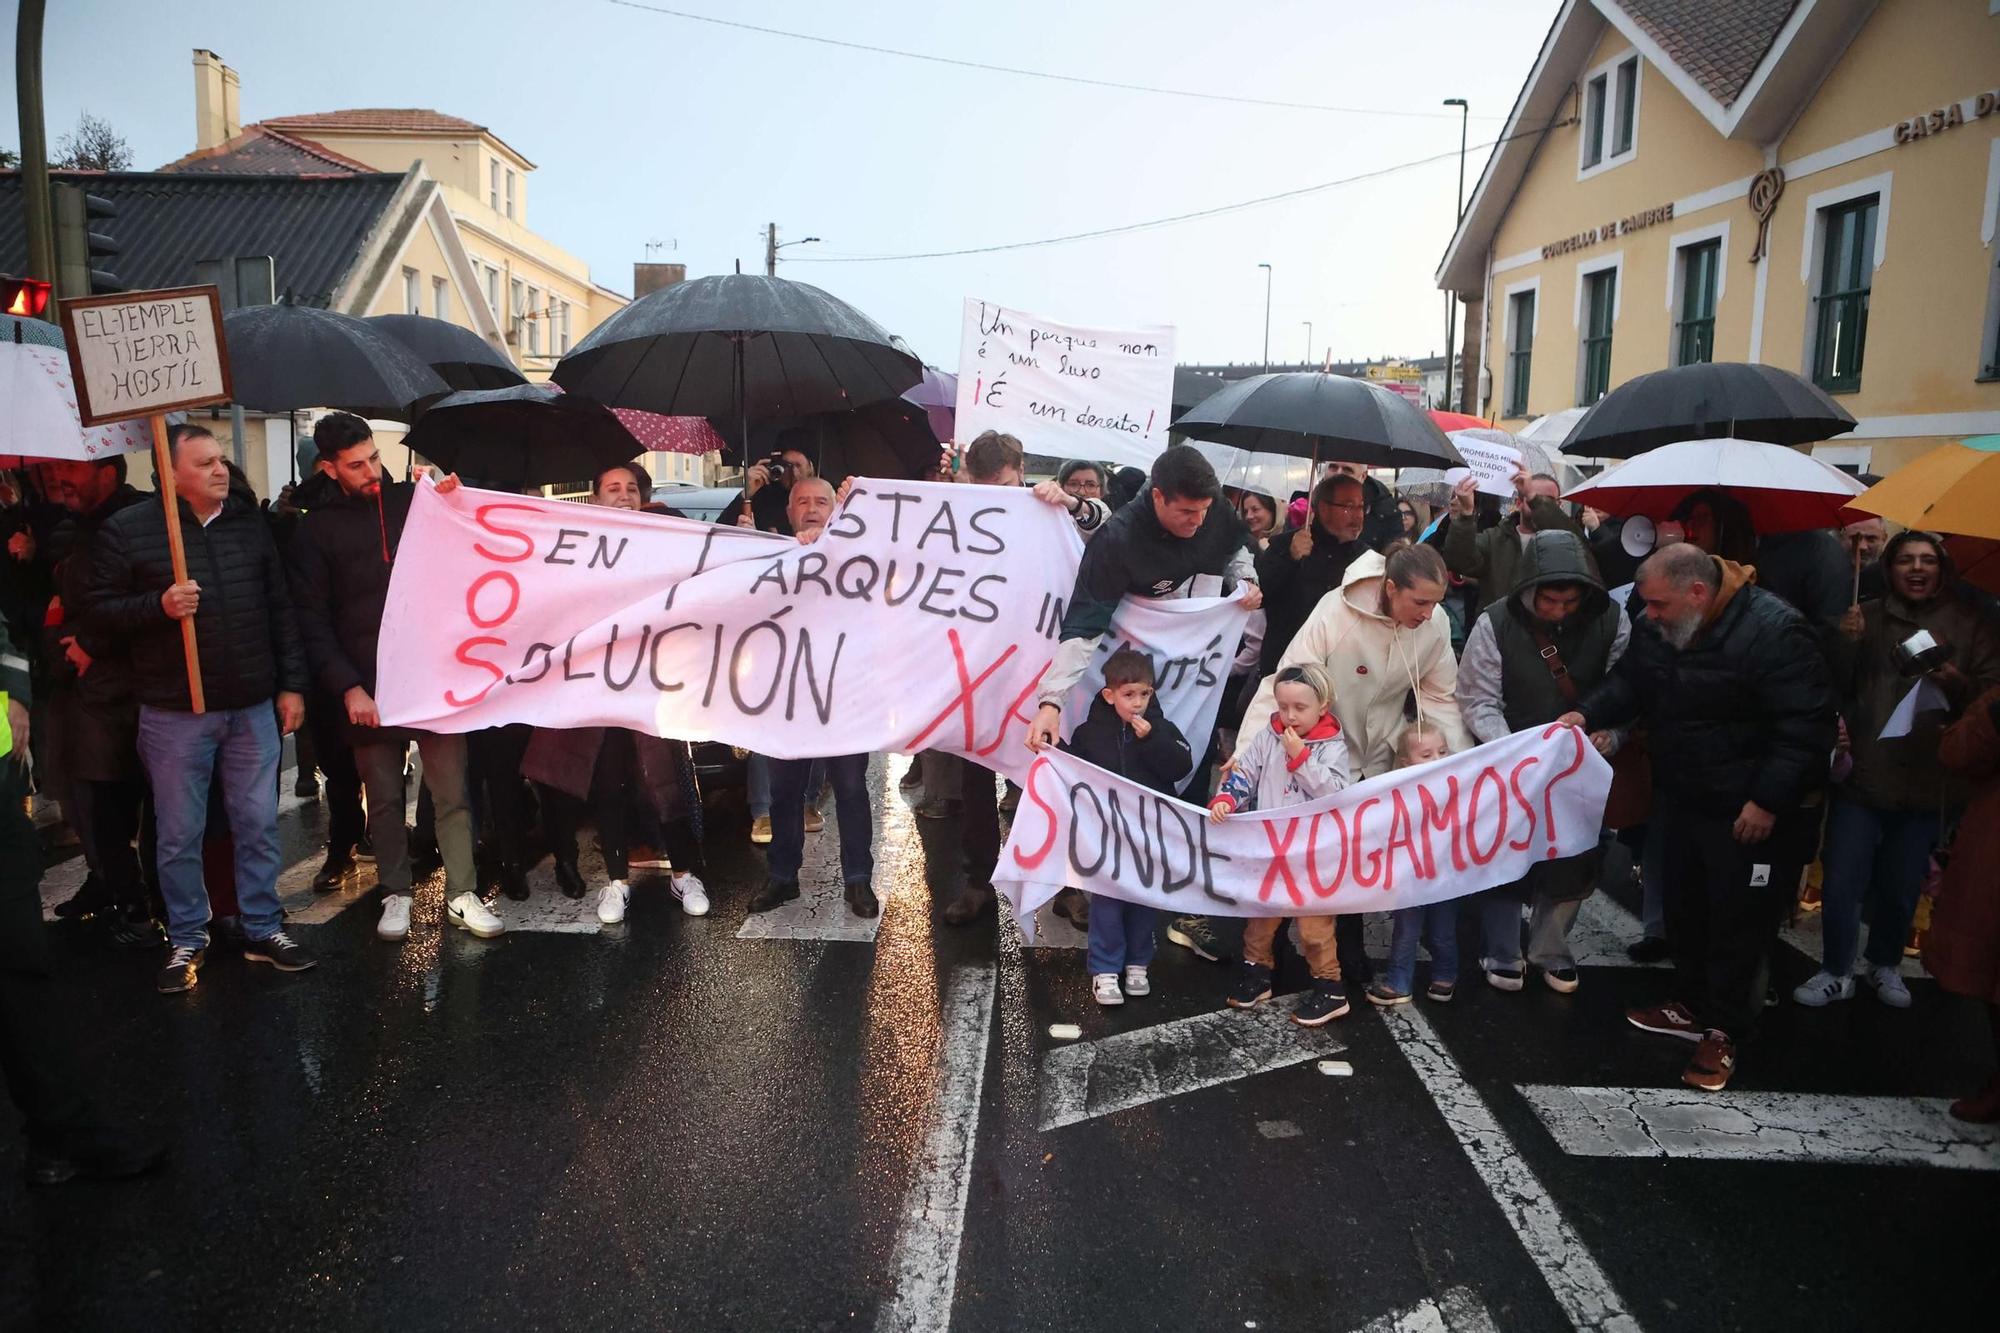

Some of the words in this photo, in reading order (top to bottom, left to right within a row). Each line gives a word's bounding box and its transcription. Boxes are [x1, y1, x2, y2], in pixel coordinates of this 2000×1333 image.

[1893, 103, 1963, 144] CASA
[1974, 92, 2000, 117] D
[1541, 229, 1597, 260] CONCELLO
[1600, 220, 1617, 241] DE
[1620, 202, 1675, 235] CAMBRE
[107, 330, 201, 364] TIERRA
[978, 301, 1014, 336] Un
[1030, 328, 1097, 351] parque
[1119, 343, 1158, 357] non
[977, 341, 987, 358] é
[1008, 352, 1041, 369] un
[1058, 354, 1101, 380] luxo
[1029, 401, 1065, 422] un
[1466, 458, 1508, 474] ESULTADOS
[1258, 722, 1585, 906] XOGAMOS?
